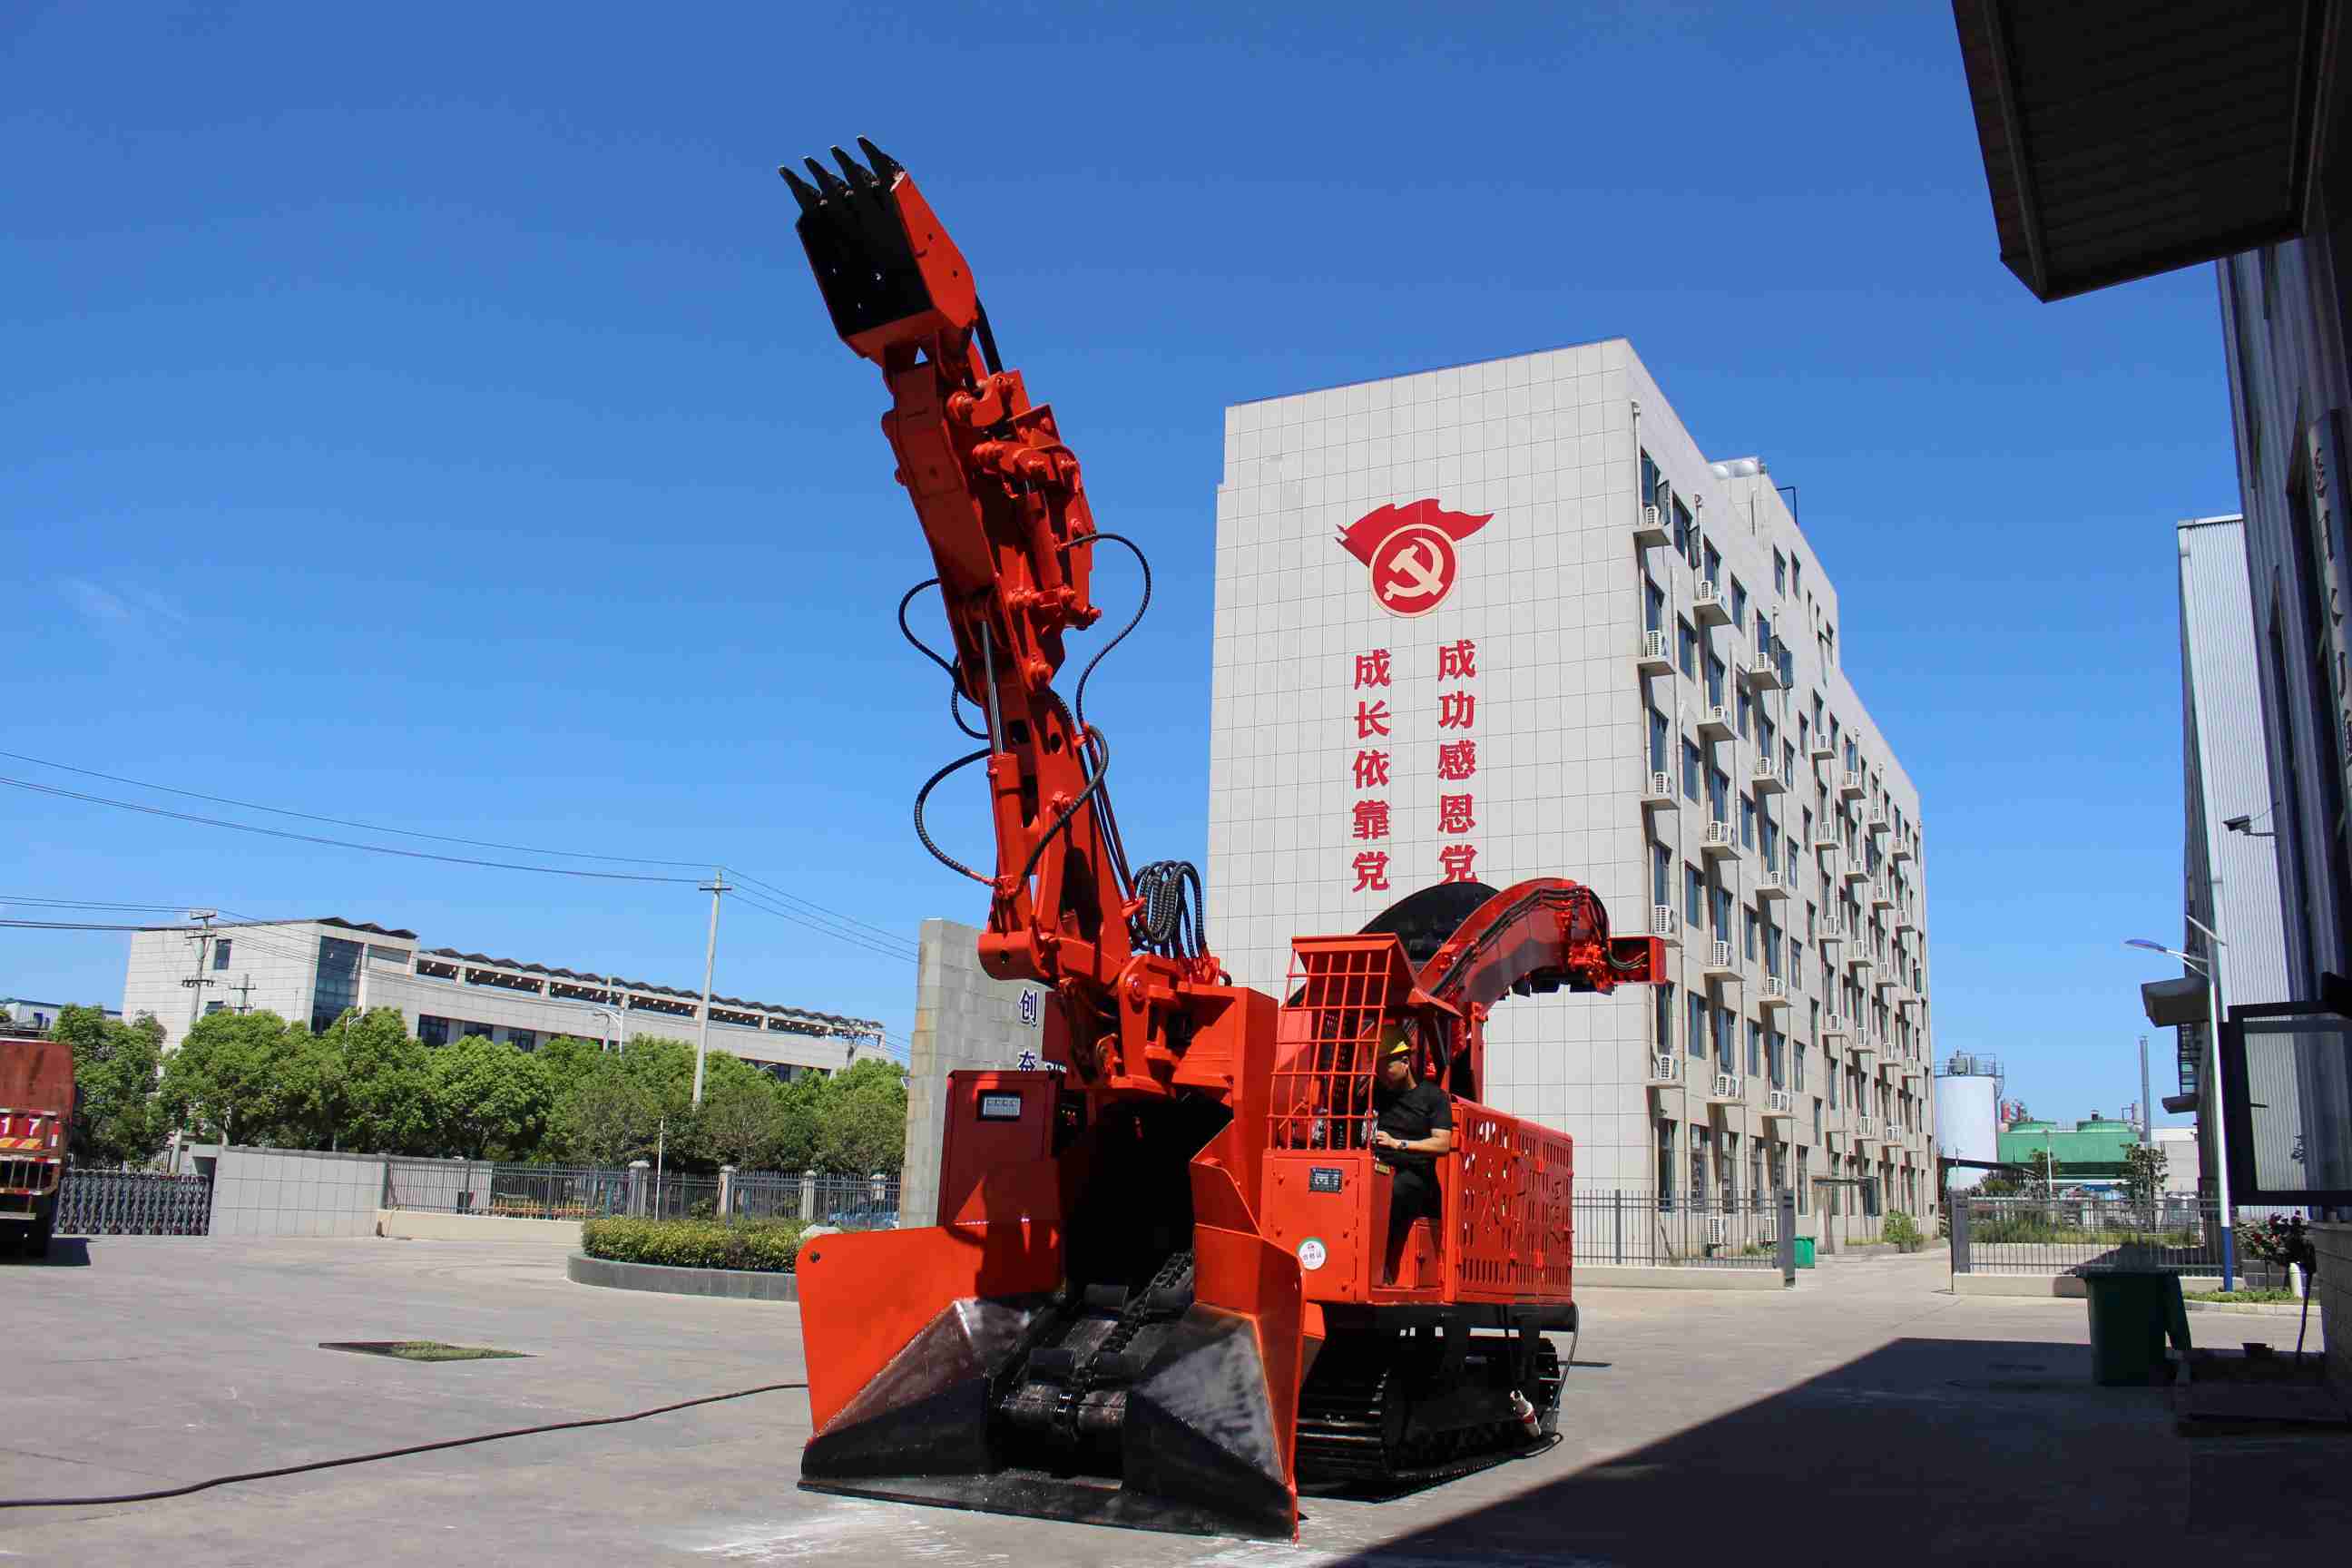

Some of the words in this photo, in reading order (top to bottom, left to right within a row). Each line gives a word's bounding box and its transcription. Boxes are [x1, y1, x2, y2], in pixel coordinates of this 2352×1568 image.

[1352, 649, 1391, 893] 成长依靠党
[1437, 639, 1478, 884] 成功感恩党
